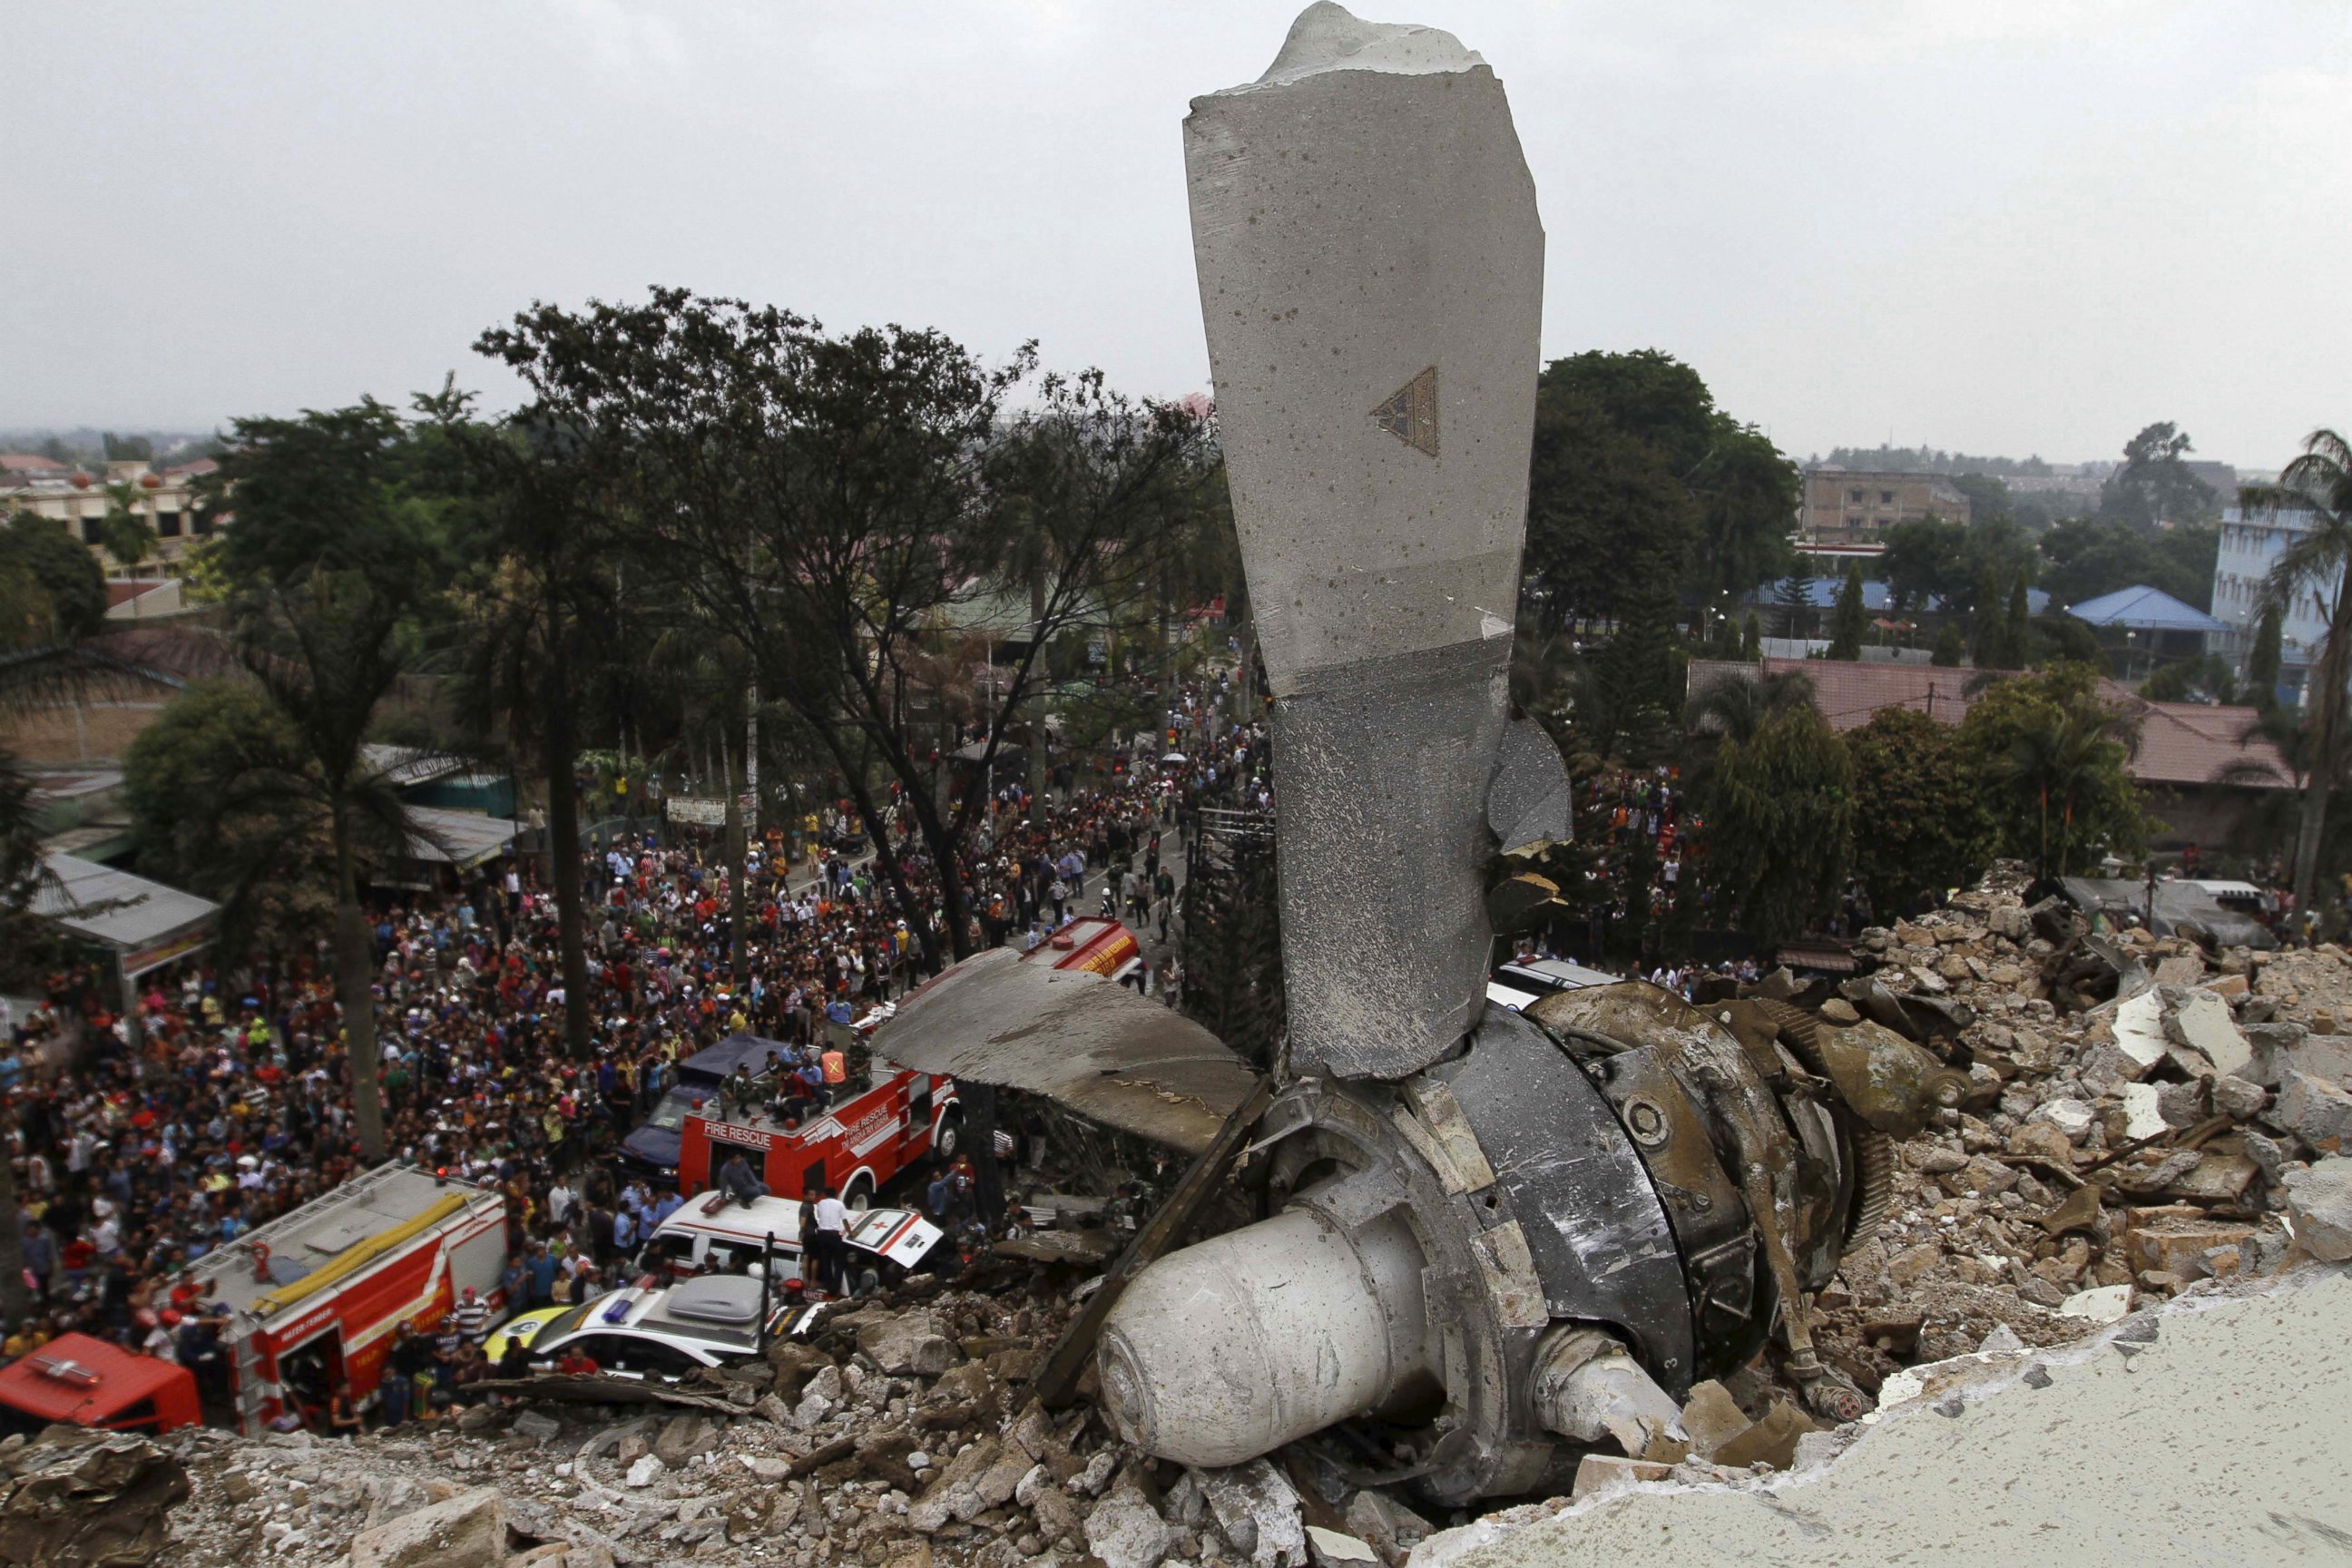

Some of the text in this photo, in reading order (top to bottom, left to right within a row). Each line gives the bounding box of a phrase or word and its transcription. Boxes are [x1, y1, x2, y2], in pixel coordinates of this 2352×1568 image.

[844, 1103, 887, 1139] FIRE RESCUE
[704, 1122, 770, 1146] FIRE RESCUE
[802, 1289, 823, 1301] ANCE
[1664, 1357, 1678, 1368] 3
